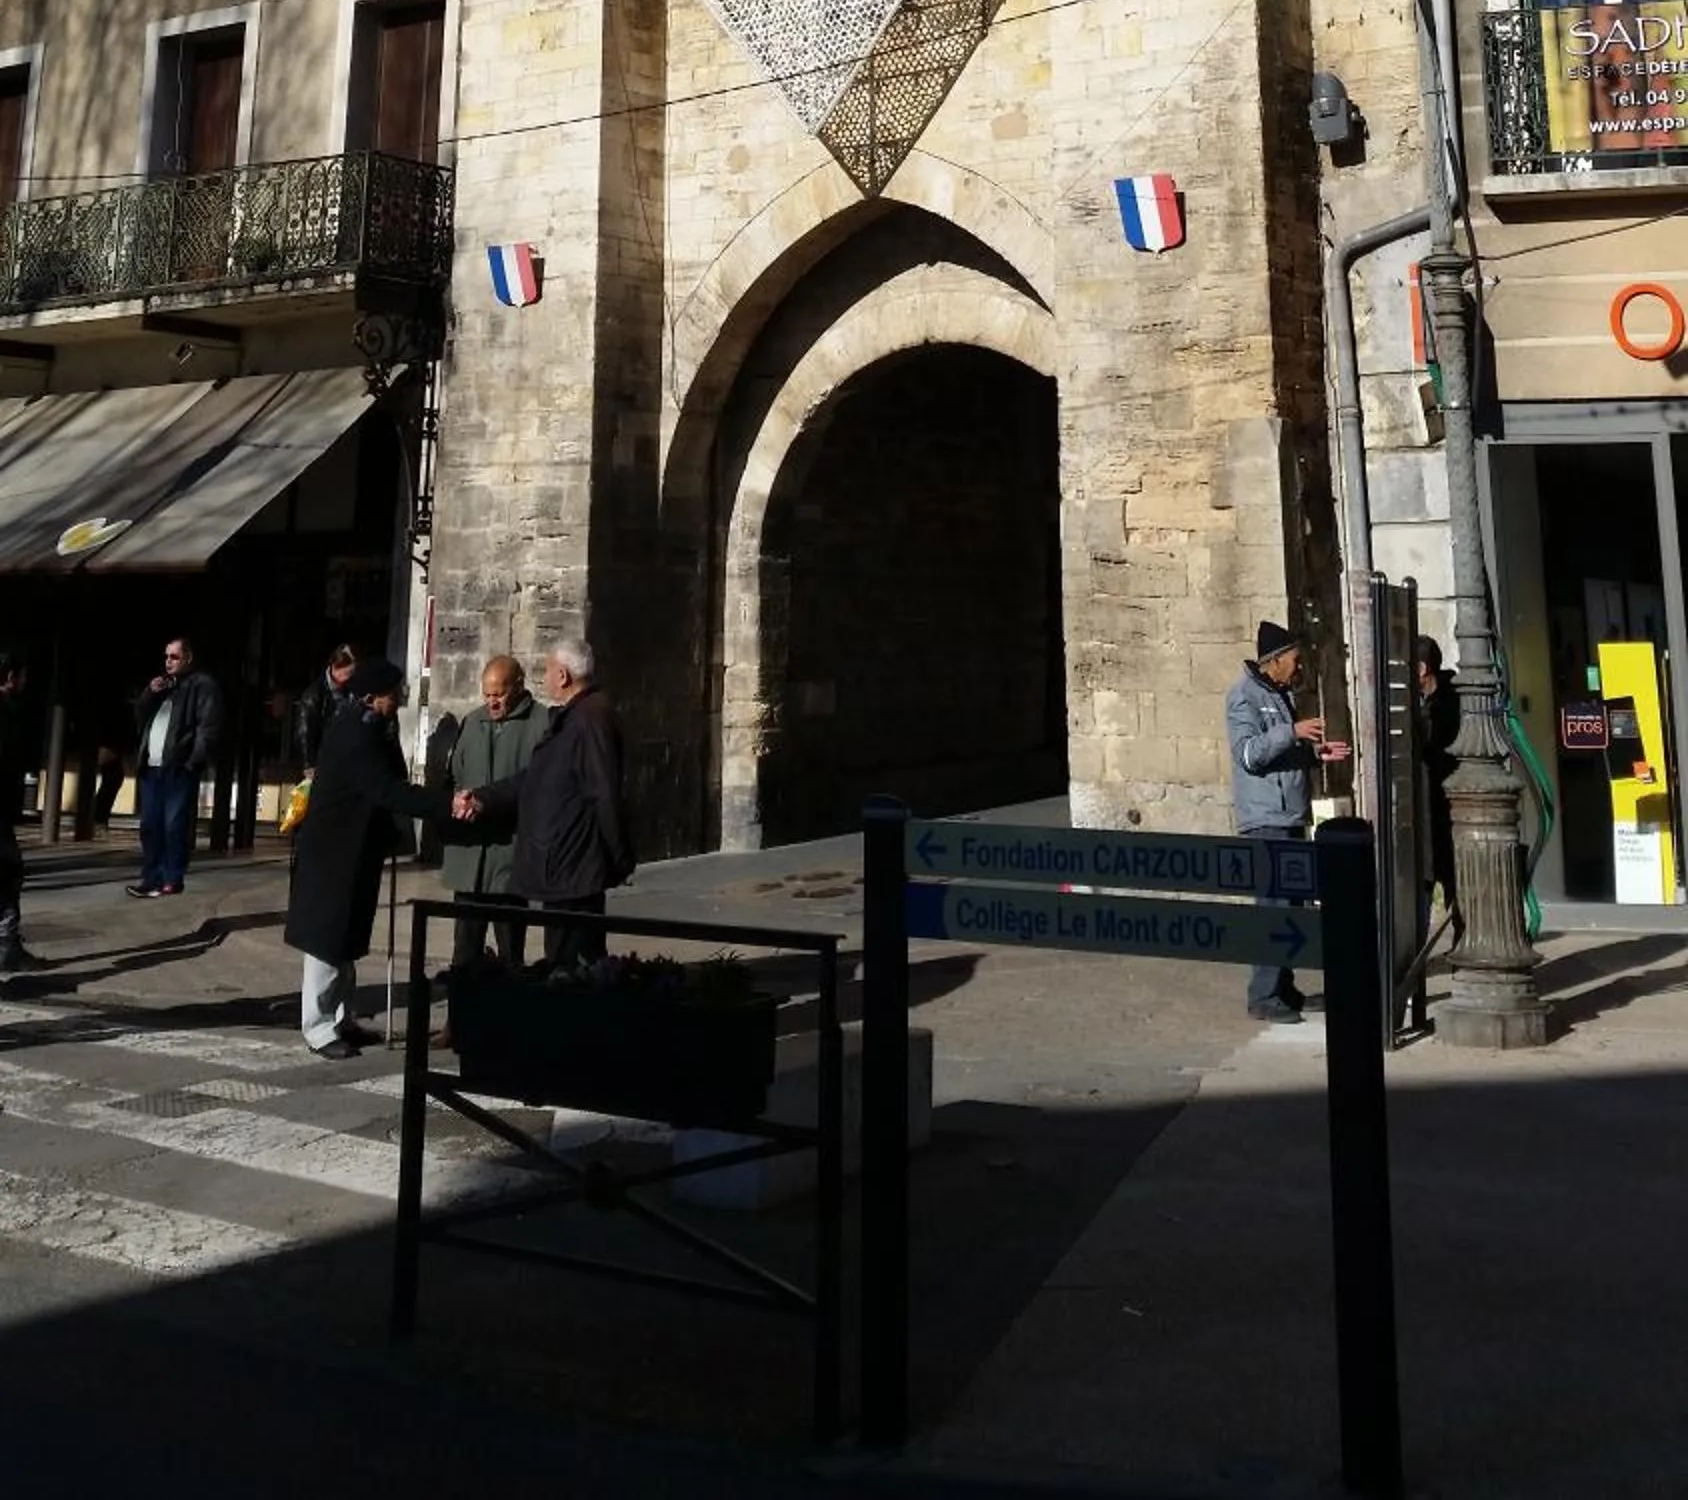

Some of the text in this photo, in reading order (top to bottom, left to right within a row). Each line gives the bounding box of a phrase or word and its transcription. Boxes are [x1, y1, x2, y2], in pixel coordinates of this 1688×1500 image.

[1567, 63, 1646, 79] ESPACE
[1609, 90, 1642, 106] Tél.
[1646, 90, 1669, 105] 04
[961, 838, 1209, 882] Fondation CARZOU
[956, 897, 1226, 949] Collège Le Mont d'Or
